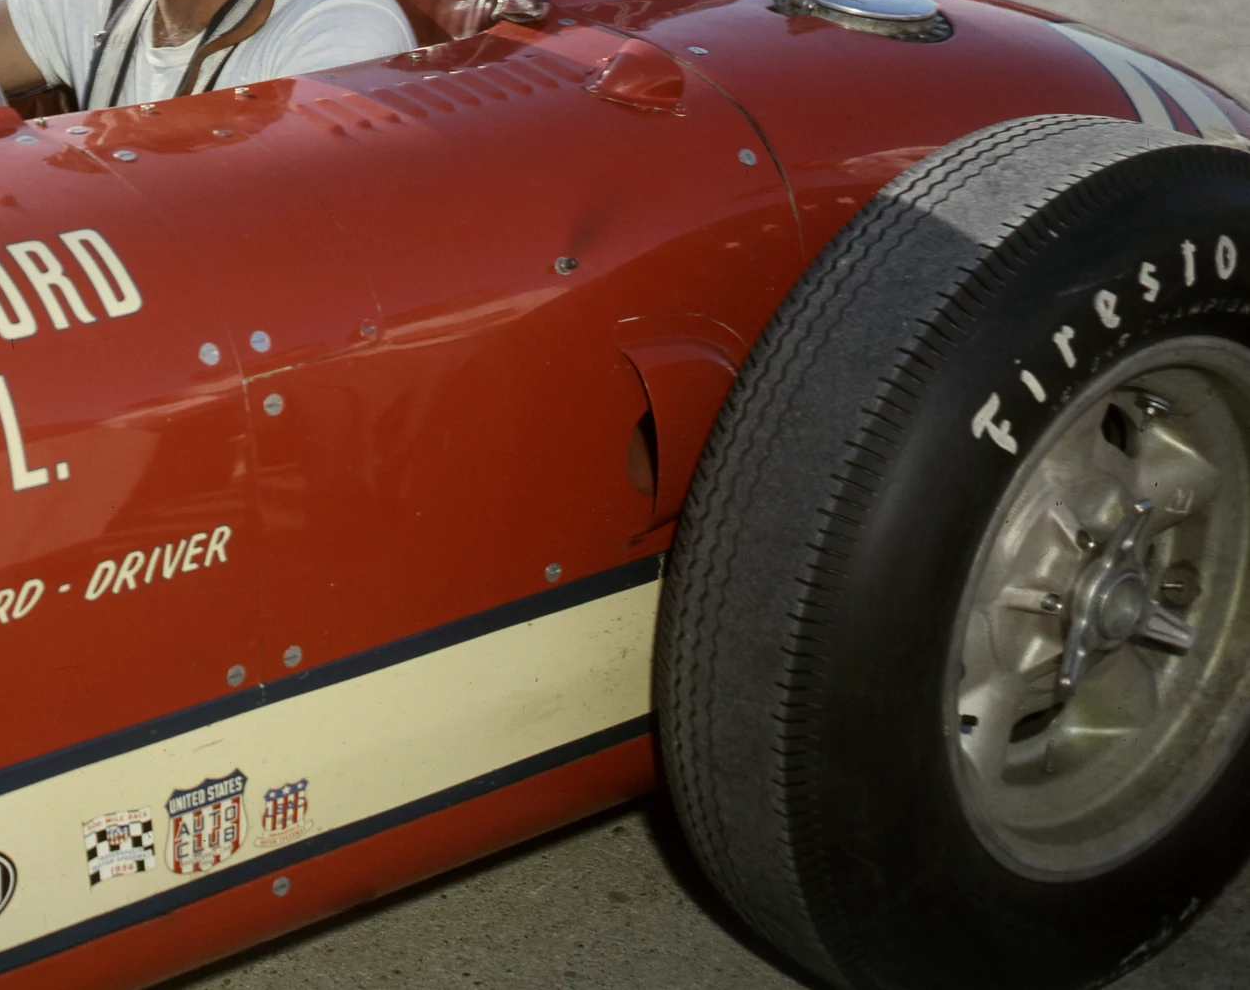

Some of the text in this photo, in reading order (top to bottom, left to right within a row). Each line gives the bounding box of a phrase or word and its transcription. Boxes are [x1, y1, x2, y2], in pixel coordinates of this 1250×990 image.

[85, 525, 232, 601] DRIVER
[169, 776, 243, 814] UNITED STATES
[177, 805, 237, 839] AUTO
[176, 825, 236, 859] CLUB
